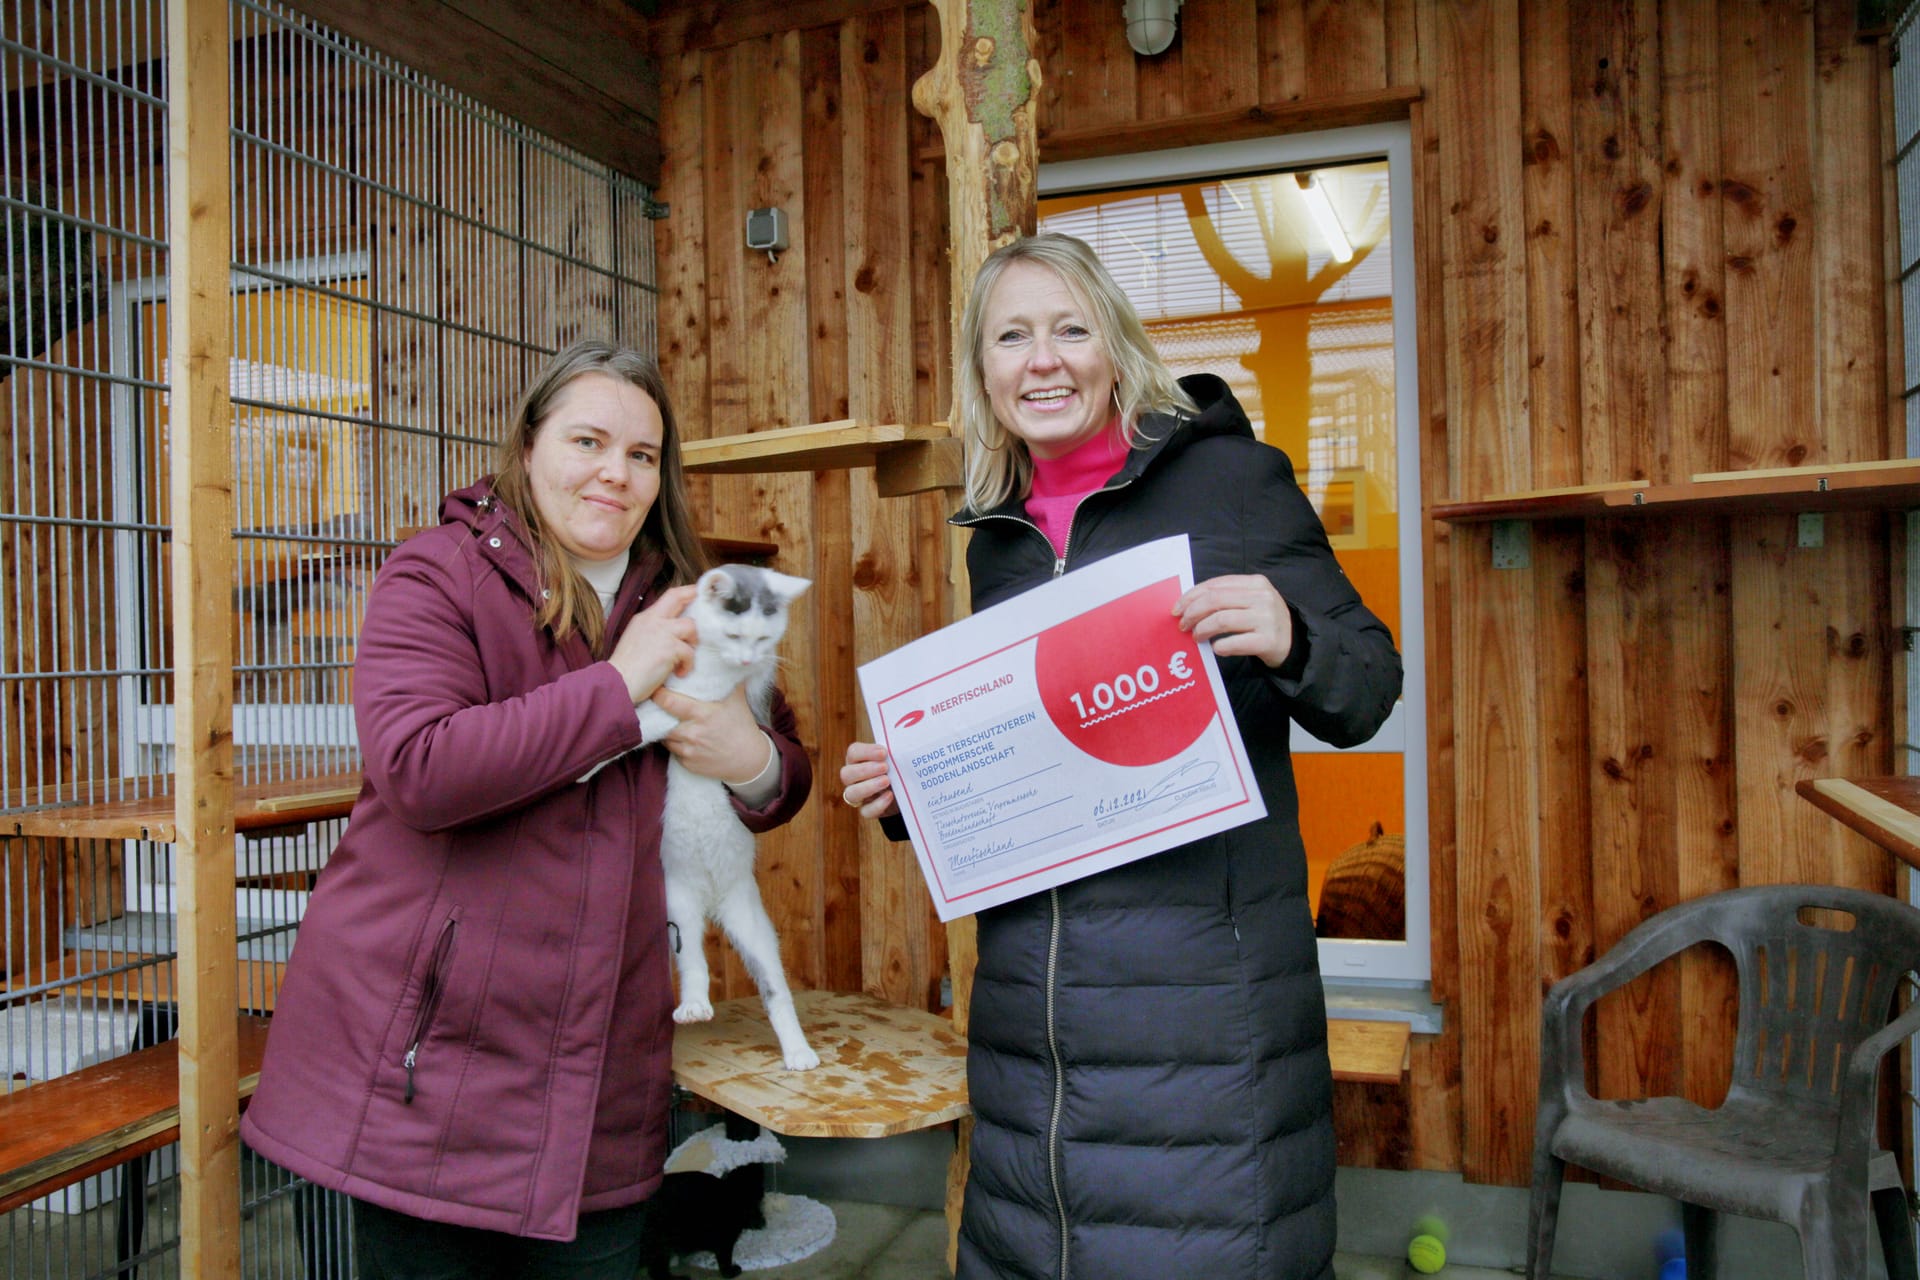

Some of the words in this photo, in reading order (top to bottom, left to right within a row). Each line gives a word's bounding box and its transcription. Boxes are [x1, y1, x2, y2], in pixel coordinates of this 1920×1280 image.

[931, 673, 1014, 716] MEERFISCHLAND
[1070, 665, 1159, 718] 1.000
[1168, 651, 1192, 679] €
[912, 748, 946, 768] SPENDE
[947, 711, 1036, 754] TIERSCHUTZVEREIN
[916, 741, 995, 779] VORPOMMERSCHE
[921, 746, 1015, 790] BODDENLANDSCHAFT
[927, 783, 974, 808] eintausend
[1093, 788, 1147, 816] 06.12.2021
[948, 836, 1015, 870] Meerfischland
